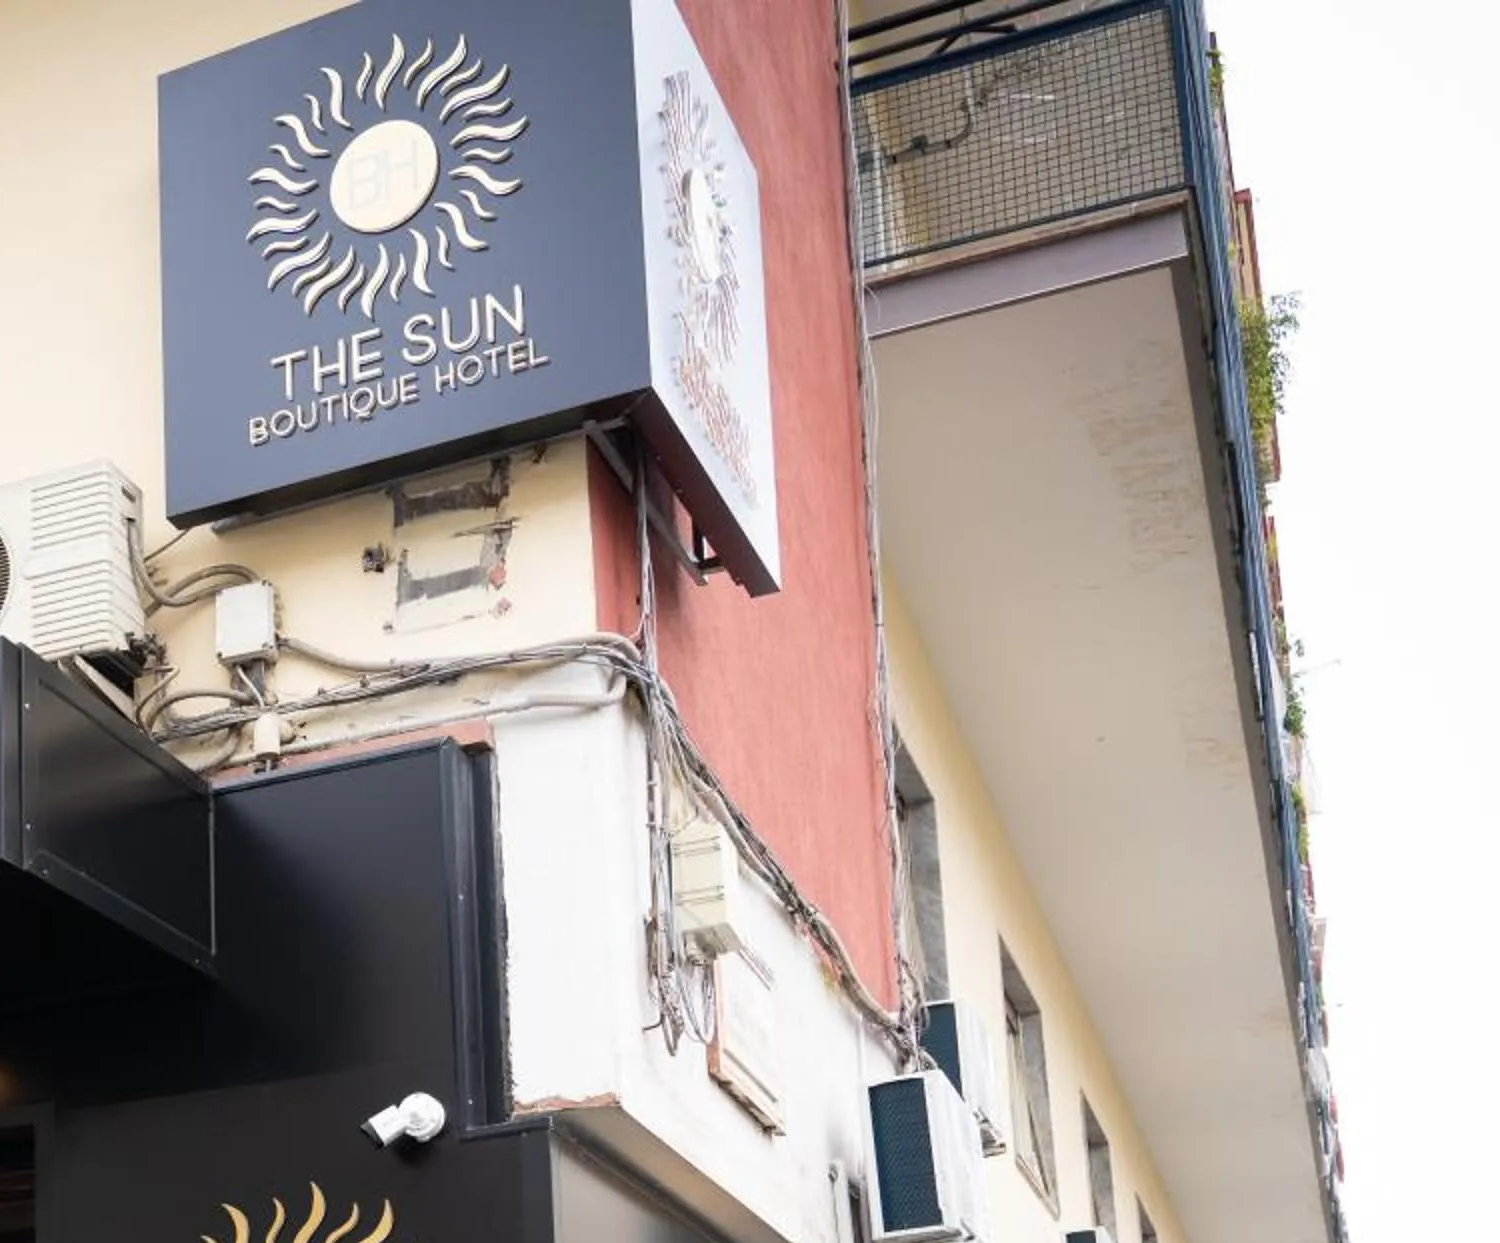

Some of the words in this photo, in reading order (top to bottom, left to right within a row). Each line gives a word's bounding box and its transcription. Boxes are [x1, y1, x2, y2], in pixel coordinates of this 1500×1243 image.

[347, 138, 419, 211] BH
[248, 371, 421, 447] BOUTIQUE
[433, 337, 550, 396] HOTEL
[270, 326, 384, 400] THE
[401, 284, 526, 365] SUN
